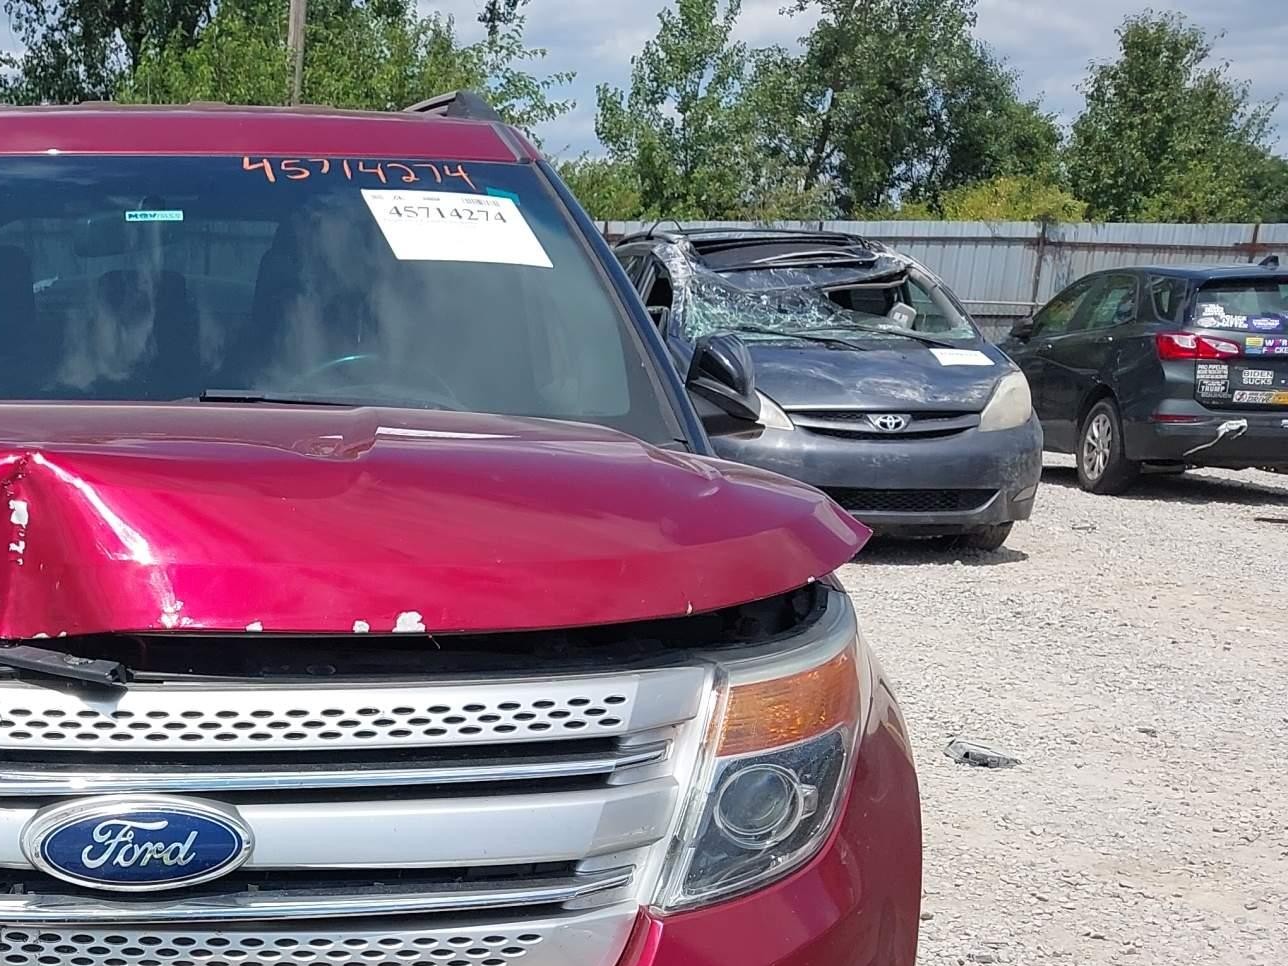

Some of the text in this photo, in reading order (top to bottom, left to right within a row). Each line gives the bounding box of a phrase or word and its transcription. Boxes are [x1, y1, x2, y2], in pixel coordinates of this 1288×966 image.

[242, 156, 477, 191] 45714274
[388, 206, 507, 223] 45714274
[1243, 370, 1273, 378] BIDEN
[81, 819, 198, 869] Ford
